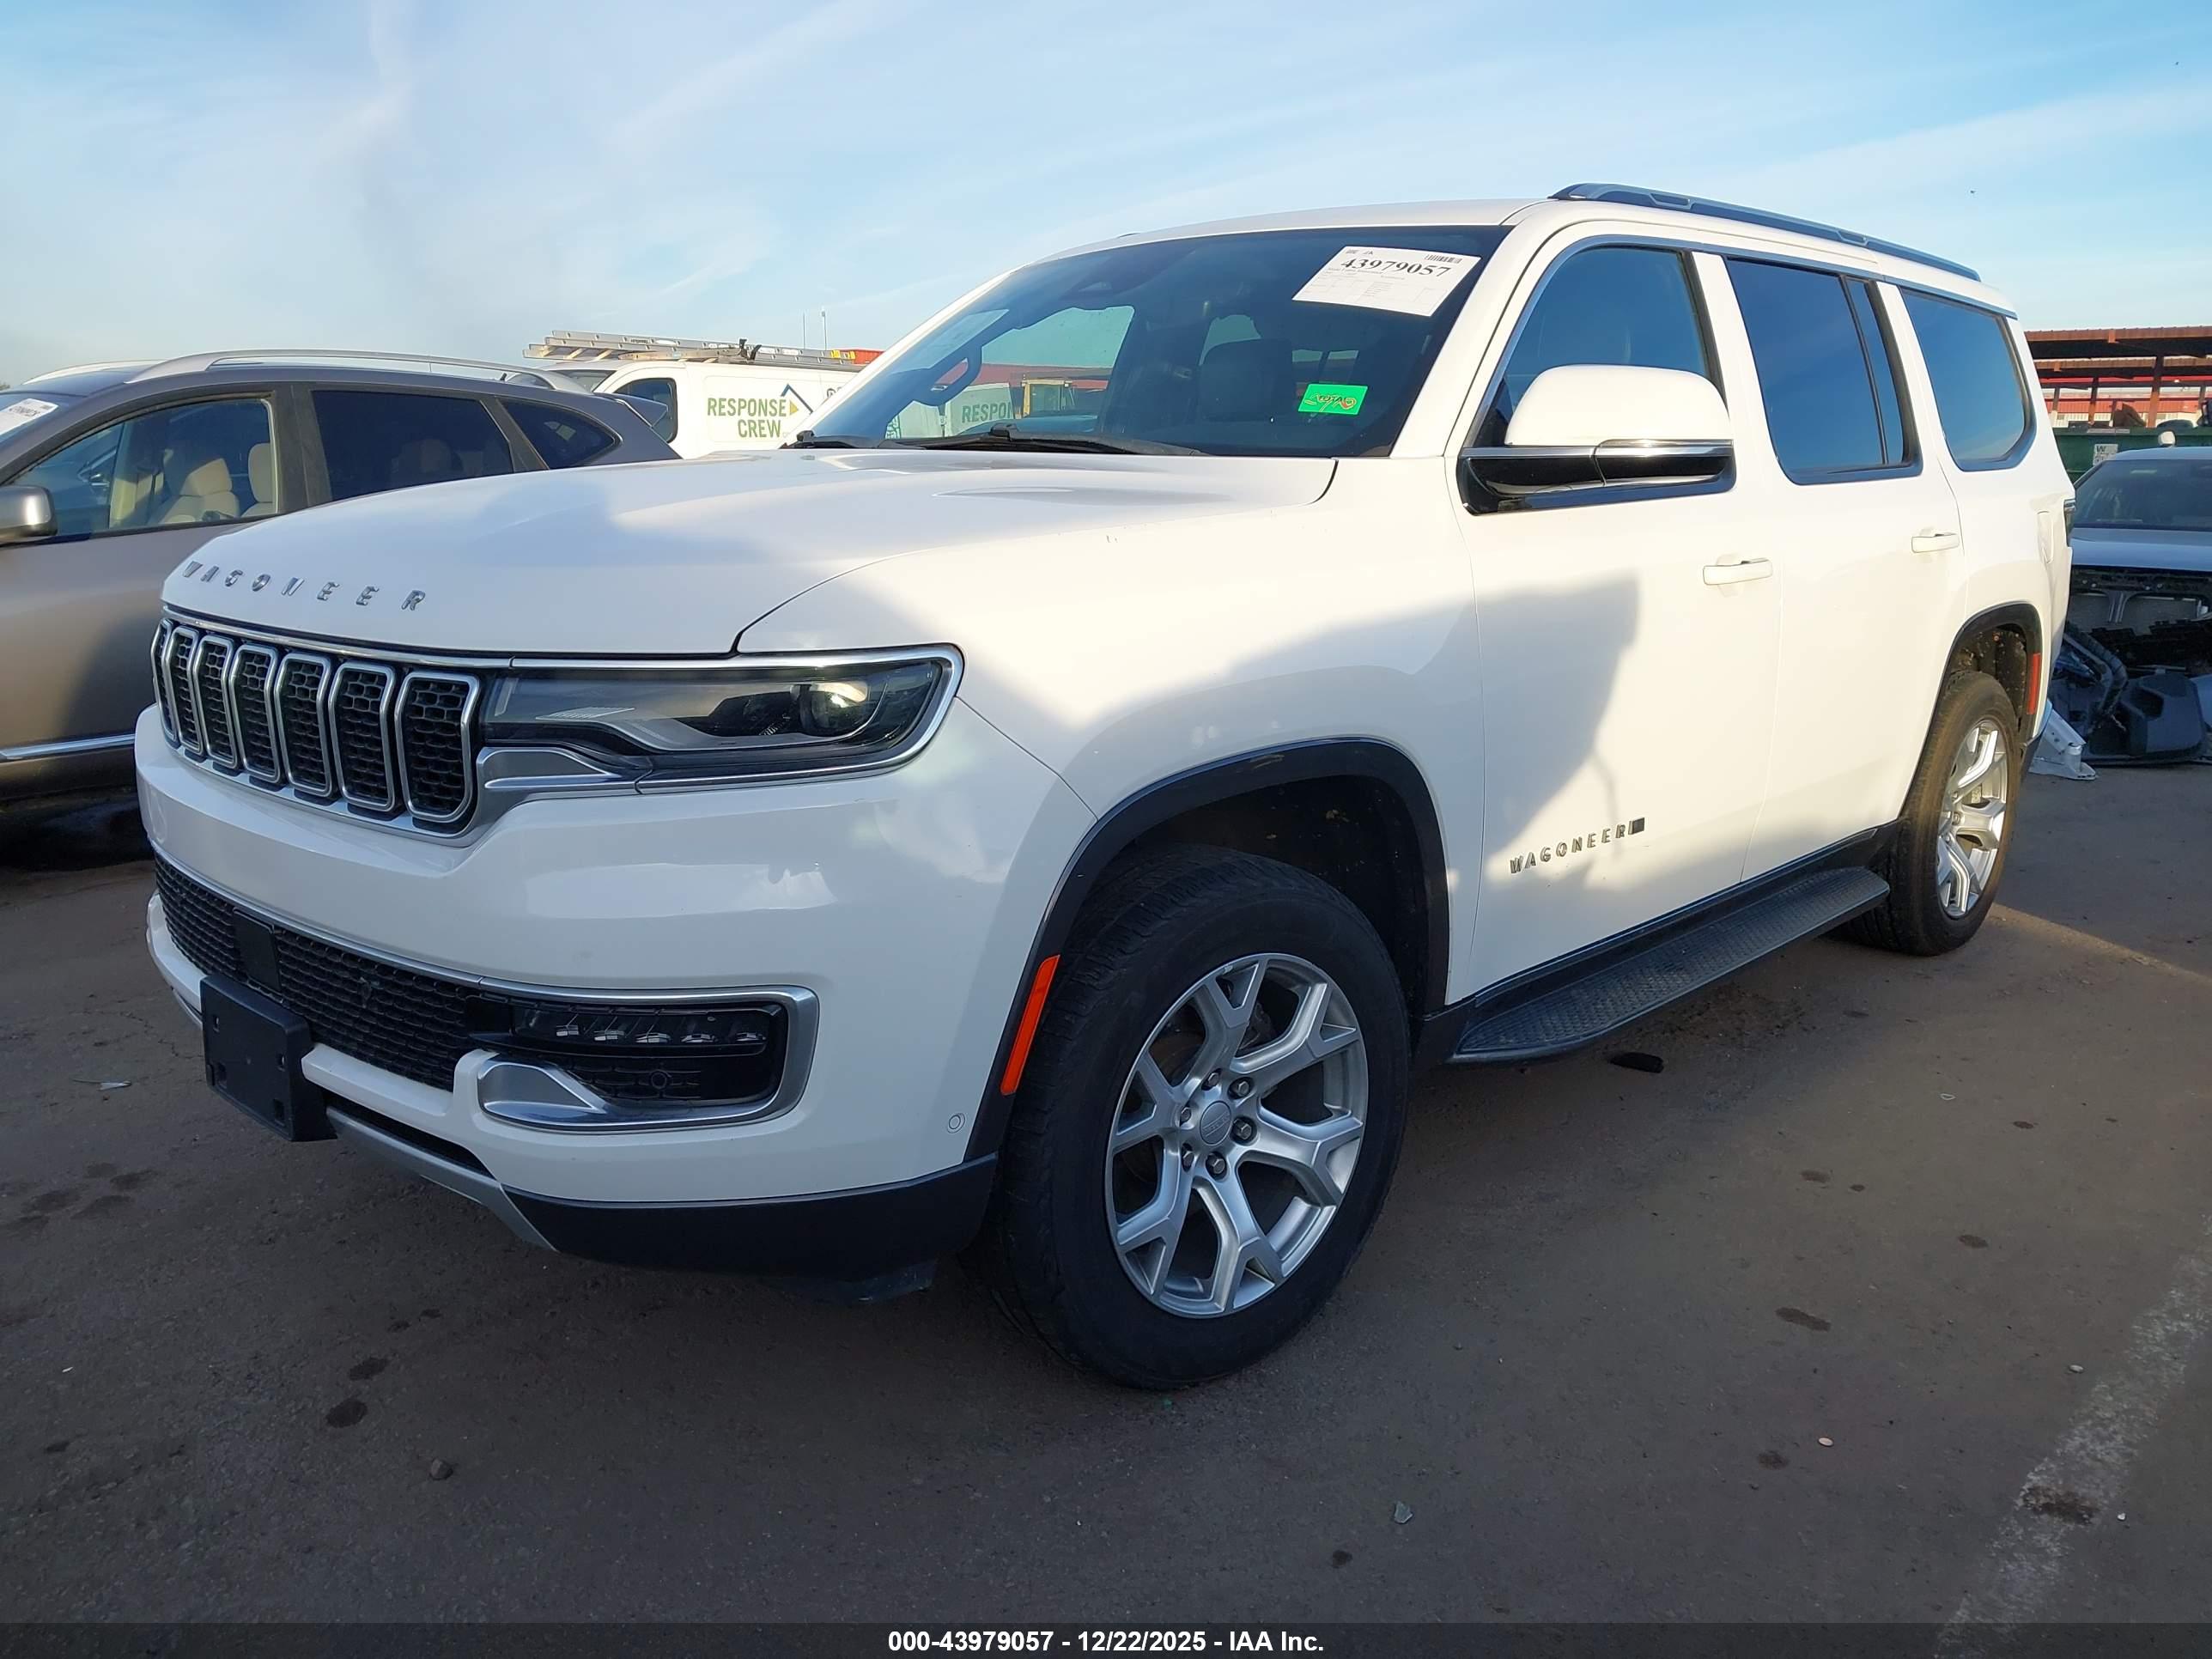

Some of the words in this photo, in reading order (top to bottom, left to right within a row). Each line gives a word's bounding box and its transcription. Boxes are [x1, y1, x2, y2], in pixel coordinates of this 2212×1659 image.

[1341, 258, 1451, 276] 43979057
[707, 398, 787, 417] RESPONSE
[738, 419, 781, 438] CREW
[182, 560, 427, 612] WAGONEER
[1510, 823, 1626, 874] WAGONEER
